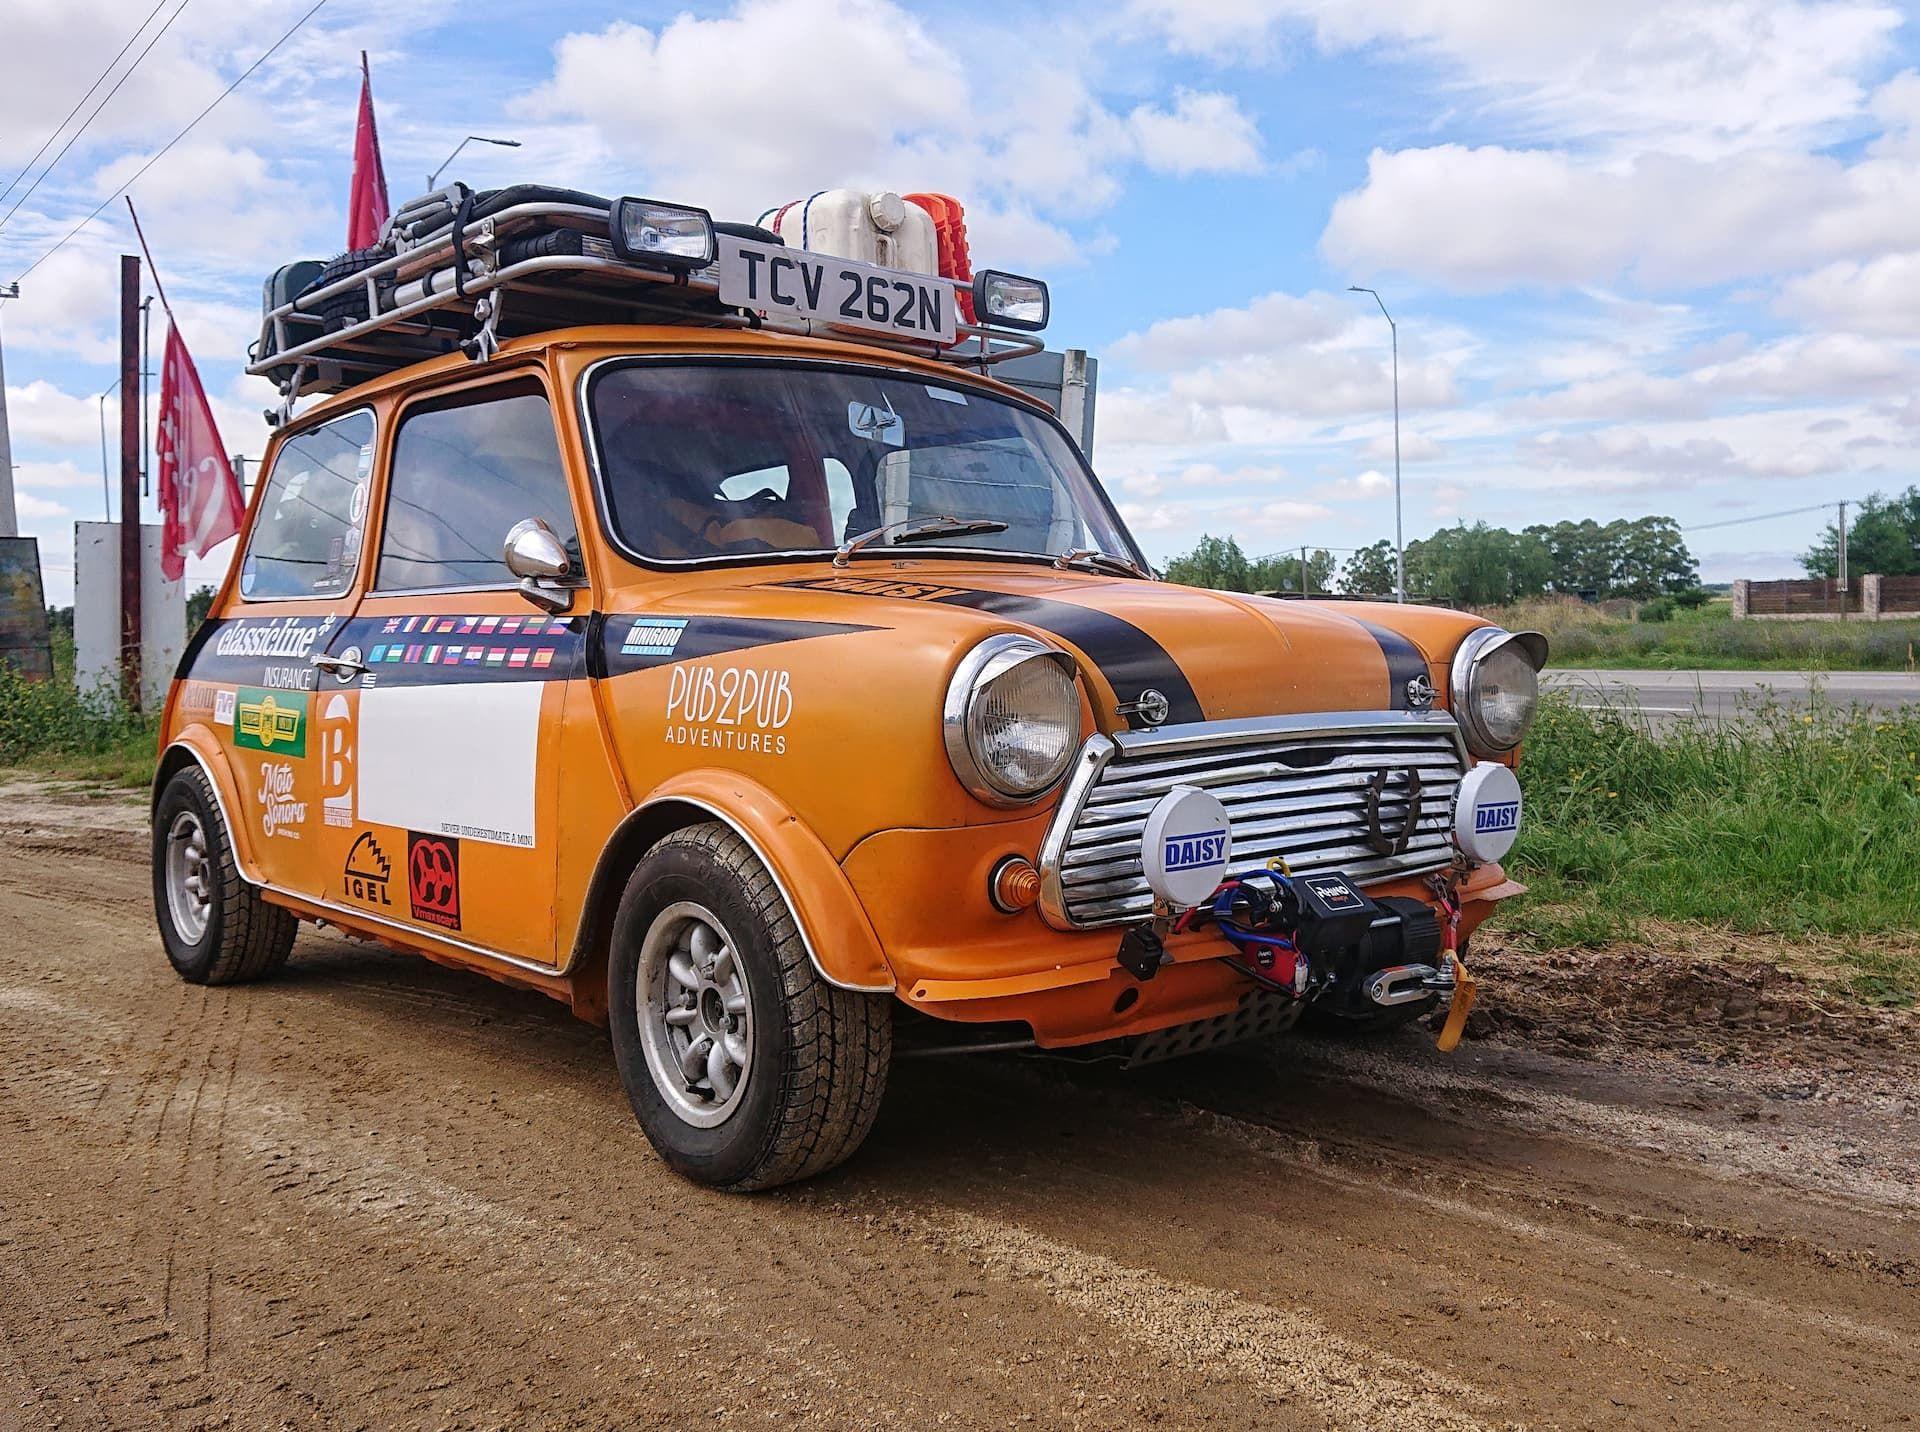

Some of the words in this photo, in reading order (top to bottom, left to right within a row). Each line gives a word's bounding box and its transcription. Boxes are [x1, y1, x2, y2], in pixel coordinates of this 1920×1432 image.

[739, 249, 824, 311] TCV
[839, 270, 941, 333] 262N
[216, 618, 318, 658] classicline
[262, 666, 313, 690] INSURANCE
[666, 665, 793, 729] PUB2PUB
[665, 725, 787, 755] ADVENTURES
[258, 762, 295, 804] Moto
[263, 793, 306, 838] Sonora
[1476, 806, 1519, 829] DAISY
[441, 822, 460, 834] NEVER
[461, 825, 510, 842] UNDERESTIMATE
[518, 834, 533, 846] MINI
[1165, 836, 1226, 866] DAISY
[344, 876, 392, 906] IGEL
